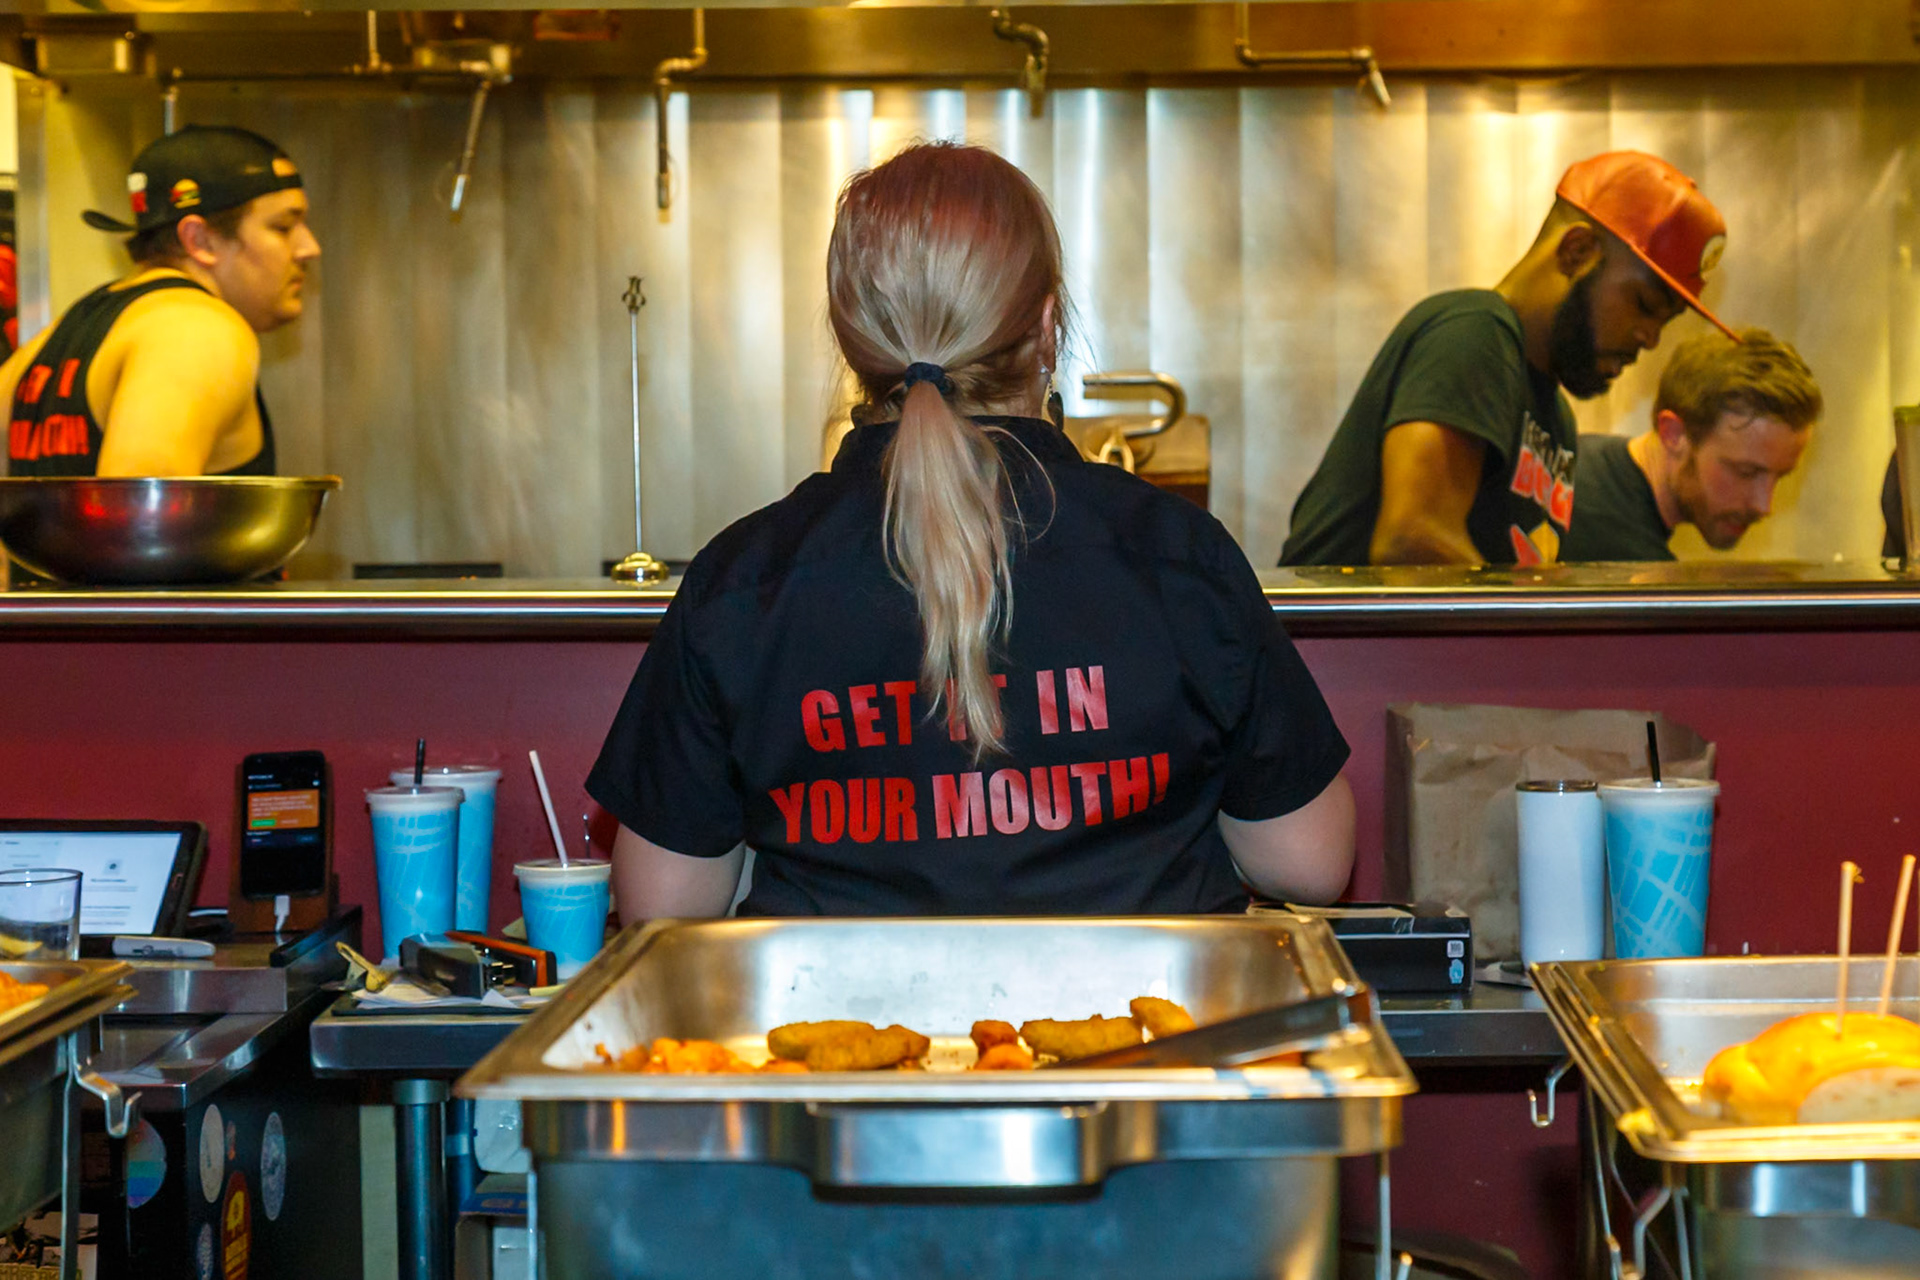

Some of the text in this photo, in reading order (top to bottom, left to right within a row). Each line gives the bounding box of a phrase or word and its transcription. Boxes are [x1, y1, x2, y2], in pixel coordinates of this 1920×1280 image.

[801, 680, 917, 753] GET
[1035, 665, 1109, 735] IN
[767, 752, 1171, 844] YOUR MOUTH!
